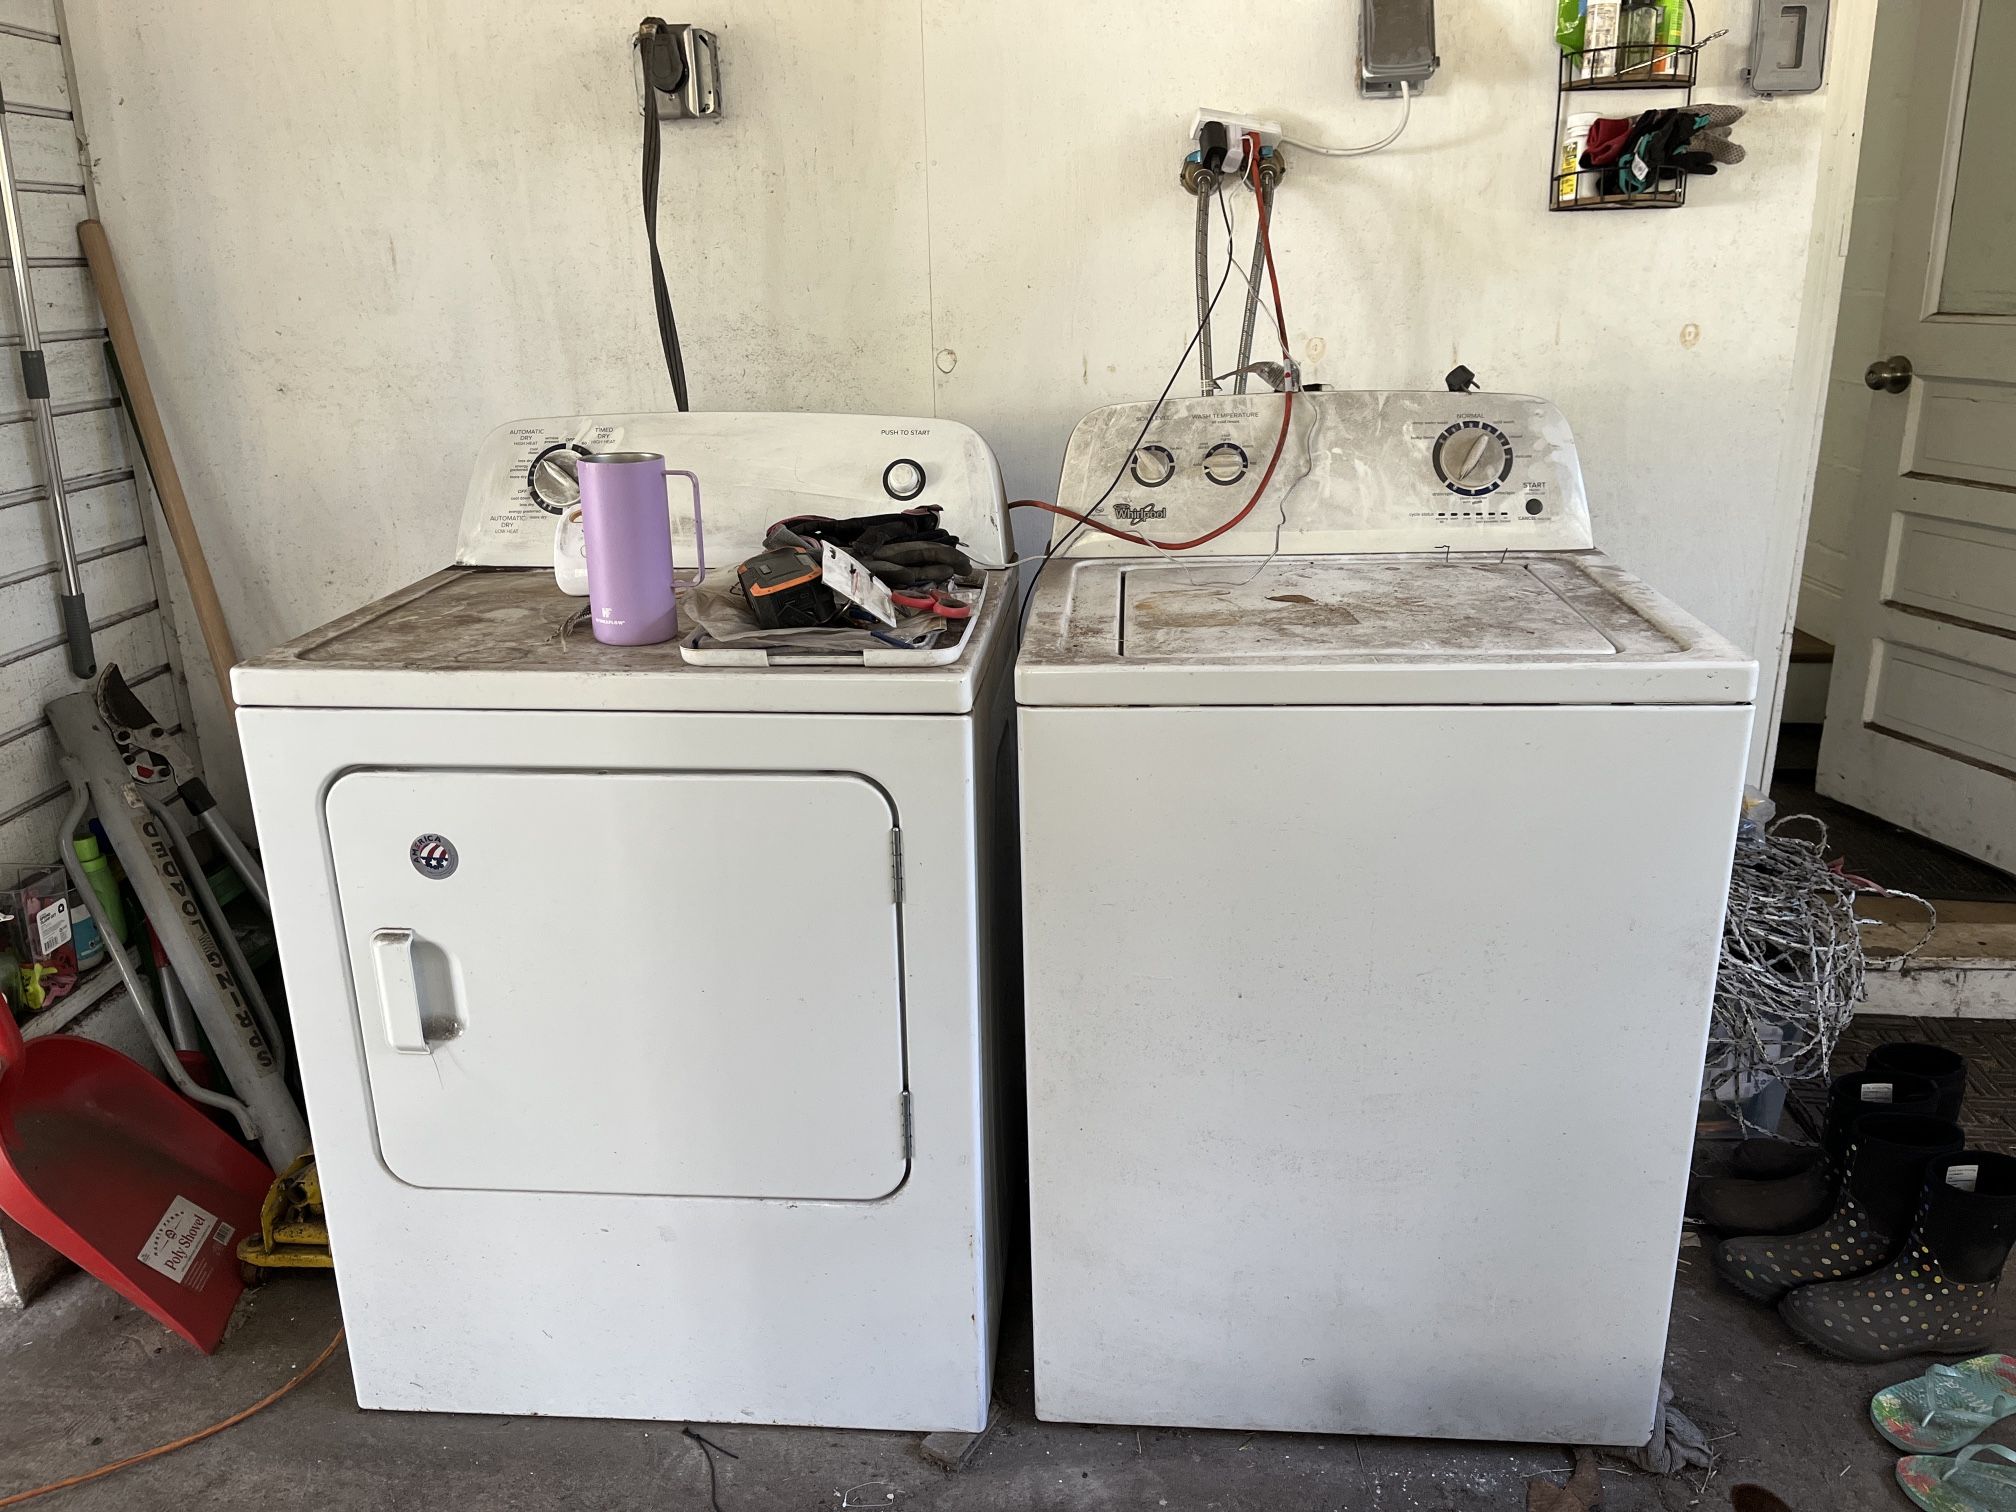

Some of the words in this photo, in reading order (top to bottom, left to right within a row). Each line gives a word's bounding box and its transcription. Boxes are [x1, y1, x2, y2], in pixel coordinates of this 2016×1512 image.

[1212, 411, 1259, 419] TEMPERATURE
[1114, 506, 1167, 522] Whirlpool
[412, 835, 442, 864] AMERICA
[142, 821, 206, 936] LOADED
[207, 951, 273, 1068] SPRING
[164, 1250, 188, 1271] Poly
[178, 1213, 206, 1249] Shovel
